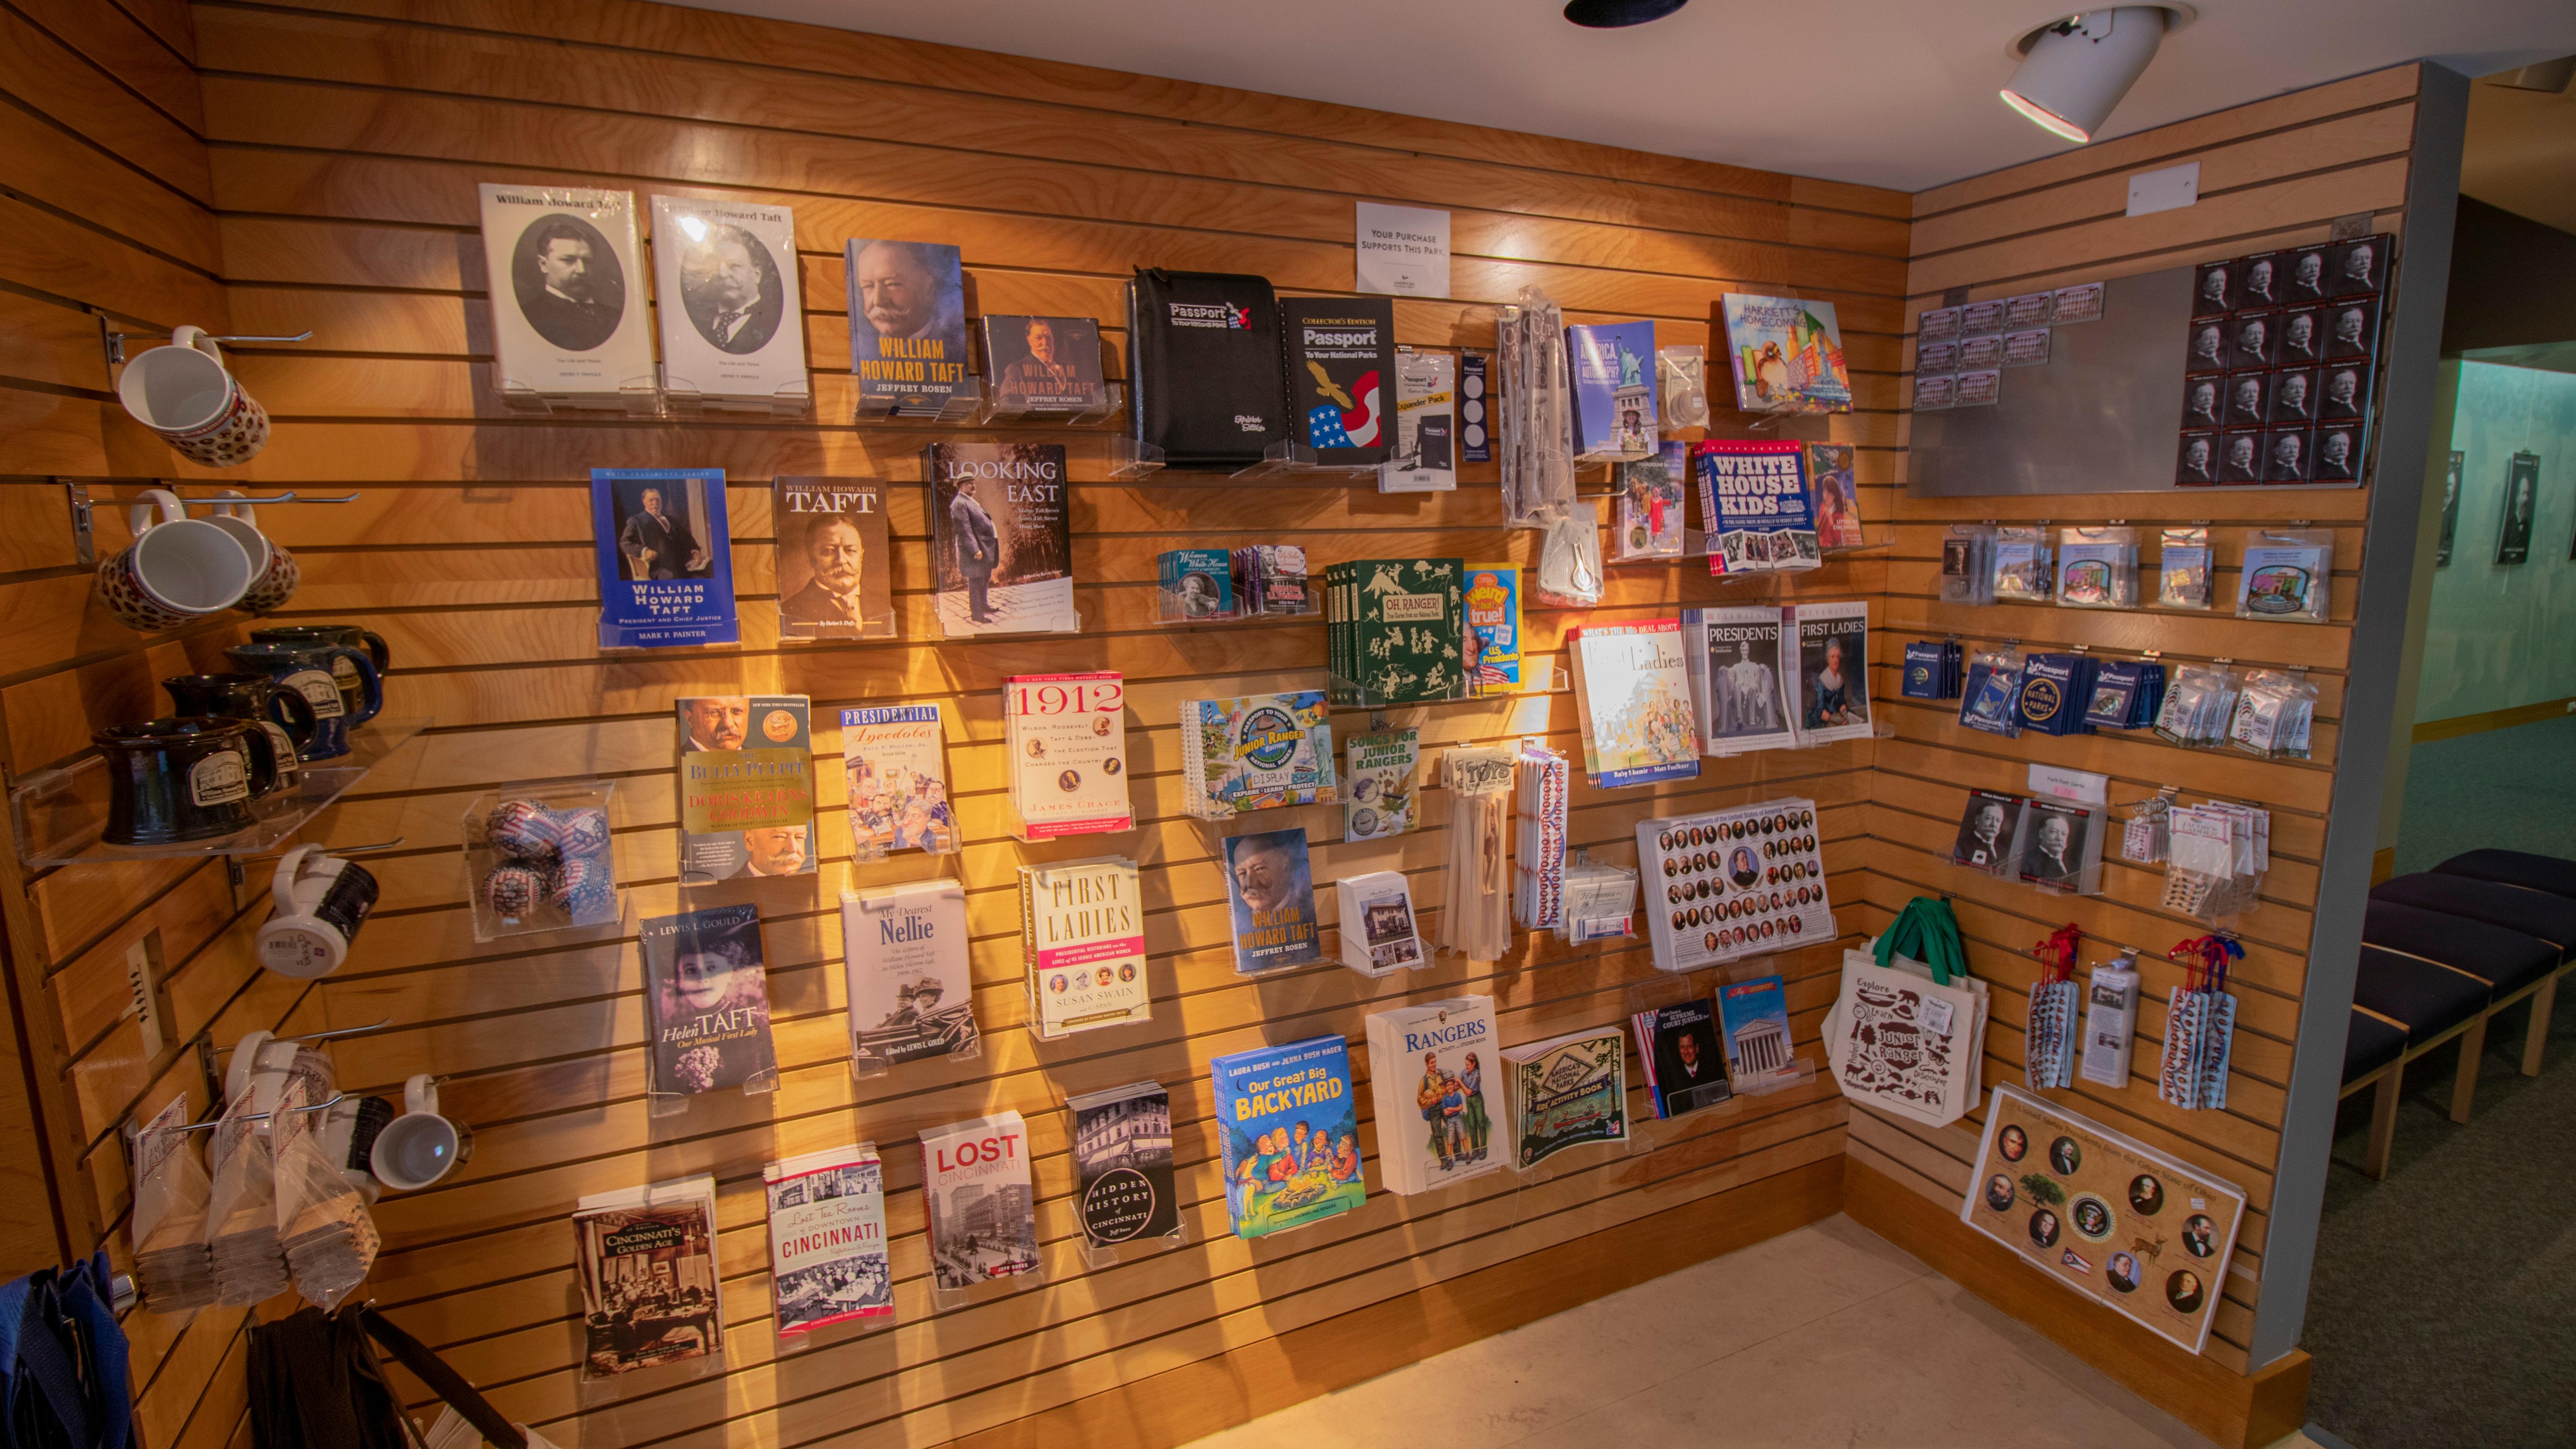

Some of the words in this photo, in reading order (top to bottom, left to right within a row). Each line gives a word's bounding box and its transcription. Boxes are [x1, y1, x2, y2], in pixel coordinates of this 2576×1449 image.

[1372, 230, 1393, 239] YOUR
[1396, 232, 1436, 243] PURCHASE
[1362, 241, 1401, 252] SUPPORTS
[1405, 245, 1421, 254] THIS
[1304, 330, 1376, 348] Passport
[879, 338, 943, 359] WILLIAM
[861, 361, 924, 381] HOWARD
[930, 363, 964, 382] TAFT
[877, 384, 918, 392] JEFFREY
[922, 385, 952, 393] ROSEN
[1397, 400, 1425, 410] Expander
[1428, 395, 1444, 403] Pack
[949, 461, 1056, 479] LOOKING
[1713, 455, 1797, 474] WHITE
[1008, 485, 1058, 502] EAST
[1716, 475, 1801, 494] HOUSE
[786, 492, 876, 513] TAFT
[1720, 495, 1778, 515] KIDS
[632, 585, 704, 594] WILLIAM
[1466, 586, 1506, 605] weird
[635, 595, 704, 605] HOWARD
[1386, 599, 1401, 611] OH,
[1403, 597, 1439, 611] RANGER!
[650, 606, 691, 615] TAFT
[1471, 607, 1502, 623] true!
[1709, 626, 1777, 642] PRESIDENTS
[1801, 623, 1829, 636] FIRST
[1831, 621, 1865, 634] LADIES
[2039, 664, 2069, 676] Passport
[1017, 684, 1123, 715] 1912
[2027, 690, 2055, 703] NATIONAL
[2029, 701, 2048, 712] PARKS
[845, 707, 935, 725] PRESIDENTIAL
[1244, 710, 1264, 732] PASSPORT
[1274, 711, 1288, 722] YOUR
[848, 725, 934, 746] Anecdotes
[1349, 736, 1392, 749] SONGS
[1397, 731, 1417, 741] FOR
[1234, 737, 1265, 761] JUNIOR
[1268, 730, 1305, 745] RANGER
[1362, 745, 1406, 759] JUNIOR
[1356, 754, 1412, 770] RANGERS
[1253, 772, 1289, 784] DISPLAY
[690, 793, 738, 808] DORIS
[744, 789, 807, 804] KEARNS
[1233, 789, 1260, 797] EXPLORE
[1288, 782, 1315, 790] PROTECT
[709, 806, 789, 821] GOODWIN
[1078, 800, 1120, 809] CHACE
[1053, 873, 1120, 908] FIRST
[1048, 906, 1131, 942] LADIES
[1252, 906, 1300, 928] WILLIAM
[880, 916, 933, 945] Nellie
[1240, 926, 1286, 950] HOWARD
[1291, 923, 1315, 941] TAFT
[1252, 946, 1283, 957] JEFFREY
[1285, 943, 1307, 952] ROSEN
[1857, 978, 1889, 993] Explore
[1057, 994, 1093, 1007] SUSAN
[1098, 988, 1133, 1000] SWAIN
[696, 1006, 756, 1035] TAFT
[1670, 1010, 1695, 1021] SUPREME
[662, 1025, 699, 1043] Helen
[693, 1036, 720, 1046] Musical
[722, 1032, 738, 1041] First
[741, 1028, 758, 1037] Lady
[1405, 1019, 1486, 1053] RANGERS
[907, 1043, 923, 1051] LEWIS
[928, 1039, 944, 1047] GOULD
[1229, 1067, 1251, 1077] LAURA
[1253, 1061, 1270, 1072] BUSH
[1282, 1055, 1302, 1065] JENNA
[1304, 1050, 1320, 1060] BUSH
[1322, 1046, 1342, 1055] HAGER
[1249, 1079, 1269, 1094] Our
[1274, 1071, 1305, 1088] Great
[1309, 1068, 1326, 1079] Big
[1552, 1071, 1580, 1085] NATIONAL
[1556, 1079, 1574, 1089] PARKS
[1235, 1078, 1343, 1121] BACKYARD
[1536, 1101, 1549, 1111] KIDS'
[1550, 1091, 1578, 1106] ACTIVITY
[1580, 1083, 1602, 1095] BOOK
[937, 1134, 1019, 1173] LOST
[2043, 1117, 2063, 1130] States
[2065, 1127, 2101, 1149] Presidents
[2103, 1144, 2122, 1159] from
[2124, 1154, 2137, 1164] the
[2138, 1159, 2159, 1173] Great
[2162, 1170, 2181, 1185] State
[2183, 1182, 2192, 1191] of
[2195, 1187, 2216, 1202] Ohio
[938, 1159, 1021, 1186] CINCINNATI
[1092, 1180, 1146, 1197] HIDDEN
[1087, 1192, 1148, 1212] HISTORY
[788, 1212, 814, 1228] Lost
[817, 1205, 833, 1219] Tea
[836, 1202, 870, 1216] Rooms
[1092, 1213, 1147, 1229] CINCINNATI
[606, 1228, 681, 1246] CINCINNATI'S
[783, 1223, 878, 1258] CINCINNATI
